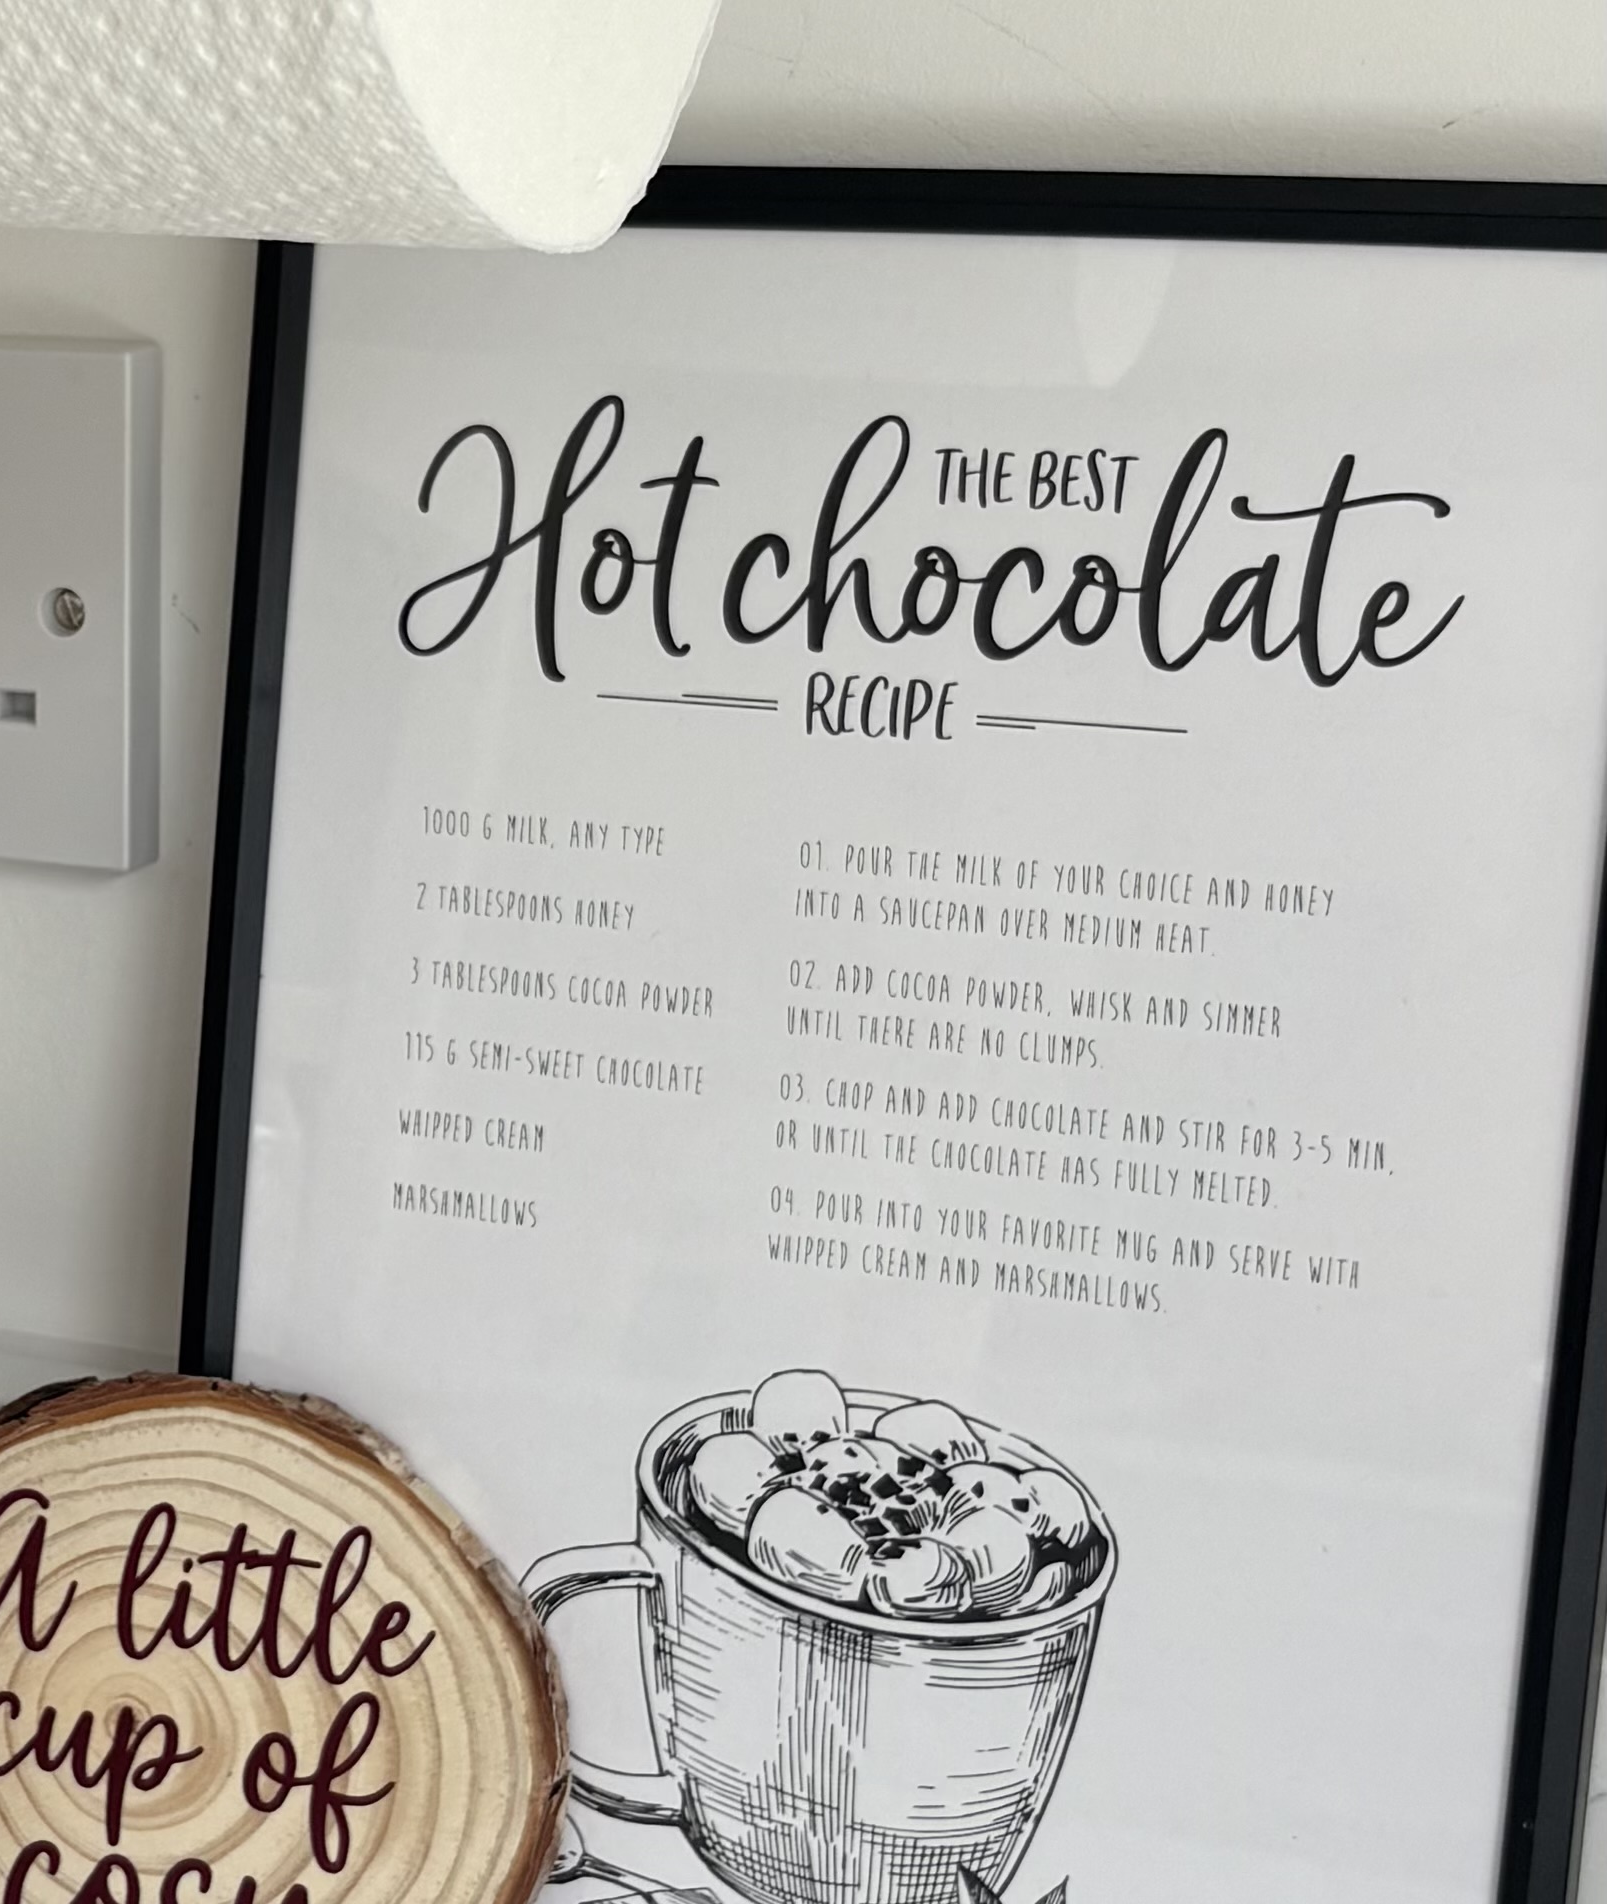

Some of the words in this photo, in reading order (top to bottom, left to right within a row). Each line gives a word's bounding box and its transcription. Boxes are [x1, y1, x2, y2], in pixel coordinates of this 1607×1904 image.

[935, 447, 1015, 510] THE
[1029, 447, 1140, 515] BEST
[398, 394, 721, 684] Hot
[722, 414, 1465, 688] chocolate
[805, 670, 959, 742] RECIPE
[423, 805, 470, 838] 1000
[482, 812, 493, 841] G
[569, 820, 609, 850] ANY
[621, 825, 665, 857] TYPE
[416, 881, 427, 910] 2
[438, 885, 563, 924] TABLESPOONS
[574, 899, 635, 930] HONEY
[845, 843, 893, 878] POUR
[908, 850, 941, 882] THE
[955, 853, 1002, 887] MILK
[1016, 859, 1039, 890] OF
[1053, 863, 1105, 897] YOUR
[1119, 868, 1194, 905] CHOICE
[1206, 876, 1251, 910] AND
[1264, 883, 1334, 917] HONEY
[795, 888, 840, 920] INTO
[853, 893, 865, 923] A
[879, 895, 985, 934] SAUCEPAN
[1000, 907, 1048, 941] OVER
[1063, 912, 1142, 950] MEDIUM
[1155, 922, 1216, 957] HEAT.
[411, 956, 420, 985] 3
[432, 960, 557, 1001] TABLESPOONS
[568, 975, 627, 1008] COCOA
[641, 981, 713, 1018] POWDER
[835, 963, 874, 996] ADD
[887, 968, 950, 1003] COCOA
[1070, 989, 1132, 1023] WHISK
[1145, 995, 1189, 1029] AND
[1202, 1000, 1281, 1039] SIMMER
[405, 1030, 435, 1063] 115
[446, 1038, 457, 1066] G
[469, 1039, 585, 1080] SEMI-SWEET
[596, 1054, 704, 1096] CHOCOLATE
[787, 1005, 842, 1042] UNTIL
[858, 1014, 915, 1049] THERE
[928, 1020, 966, 1055] ARE
[980, 1027, 1005, 1058] NO
[1019, 1031, 1104, 1071] CLUMPS.
[398, 1109, 473, 1144] WHIPPED
[484, 1117, 545, 1153] CREAM
[825, 1077, 874, 1112] CHOP
[885, 1084, 926, 1118] AND
[938, 1090, 978, 1124] ADD
[991, 1096, 1109, 1140] CHOCOLATE
[1122, 1112, 1165, 1146] AND
[1178, 1118, 1225, 1153] STIR
[1240, 1124, 1277, 1160] FOR
[1292, 1130, 1332, 1165] 3-5
[775, 1118, 797, 1150] OR
[812, 1123, 868, 1160] UNTIL
[884, 1133, 917, 1165] THE
[931, 1138, 1047, 1181] CHOCOLATE
[1060, 1155, 1100, 1187] HAS
[1114, 1159, 1179, 1197] FULLY
[1192, 1169, 1279, 1209] MELTED.
[392, 1181, 538, 1229] MARSHMALLOWS
[815, 1189, 863, 1225] POUR
[876, 1198, 923, 1233] INTO
[937, 1208, 988, 1241] YOUR
[1001, 1213, 1101, 1257] FAVORITE
[1116, 1228, 1158, 1264] MUG
[1171, 1236, 1215, 1271] AND
[1229, 1243, 1292, 1282] SERVE
[1308, 1255, 1360, 1289] WITH
[767, 1233, 849, 1270] WHIPPED
[862, 1243, 927, 1281] CREAM
[939, 1255, 980, 1288] AND
[994, 1261, 1168, 1315] MARSHMALLOWS.
[116, 1501, 436, 1686] little
[242, 1691, 397, 1875] of
